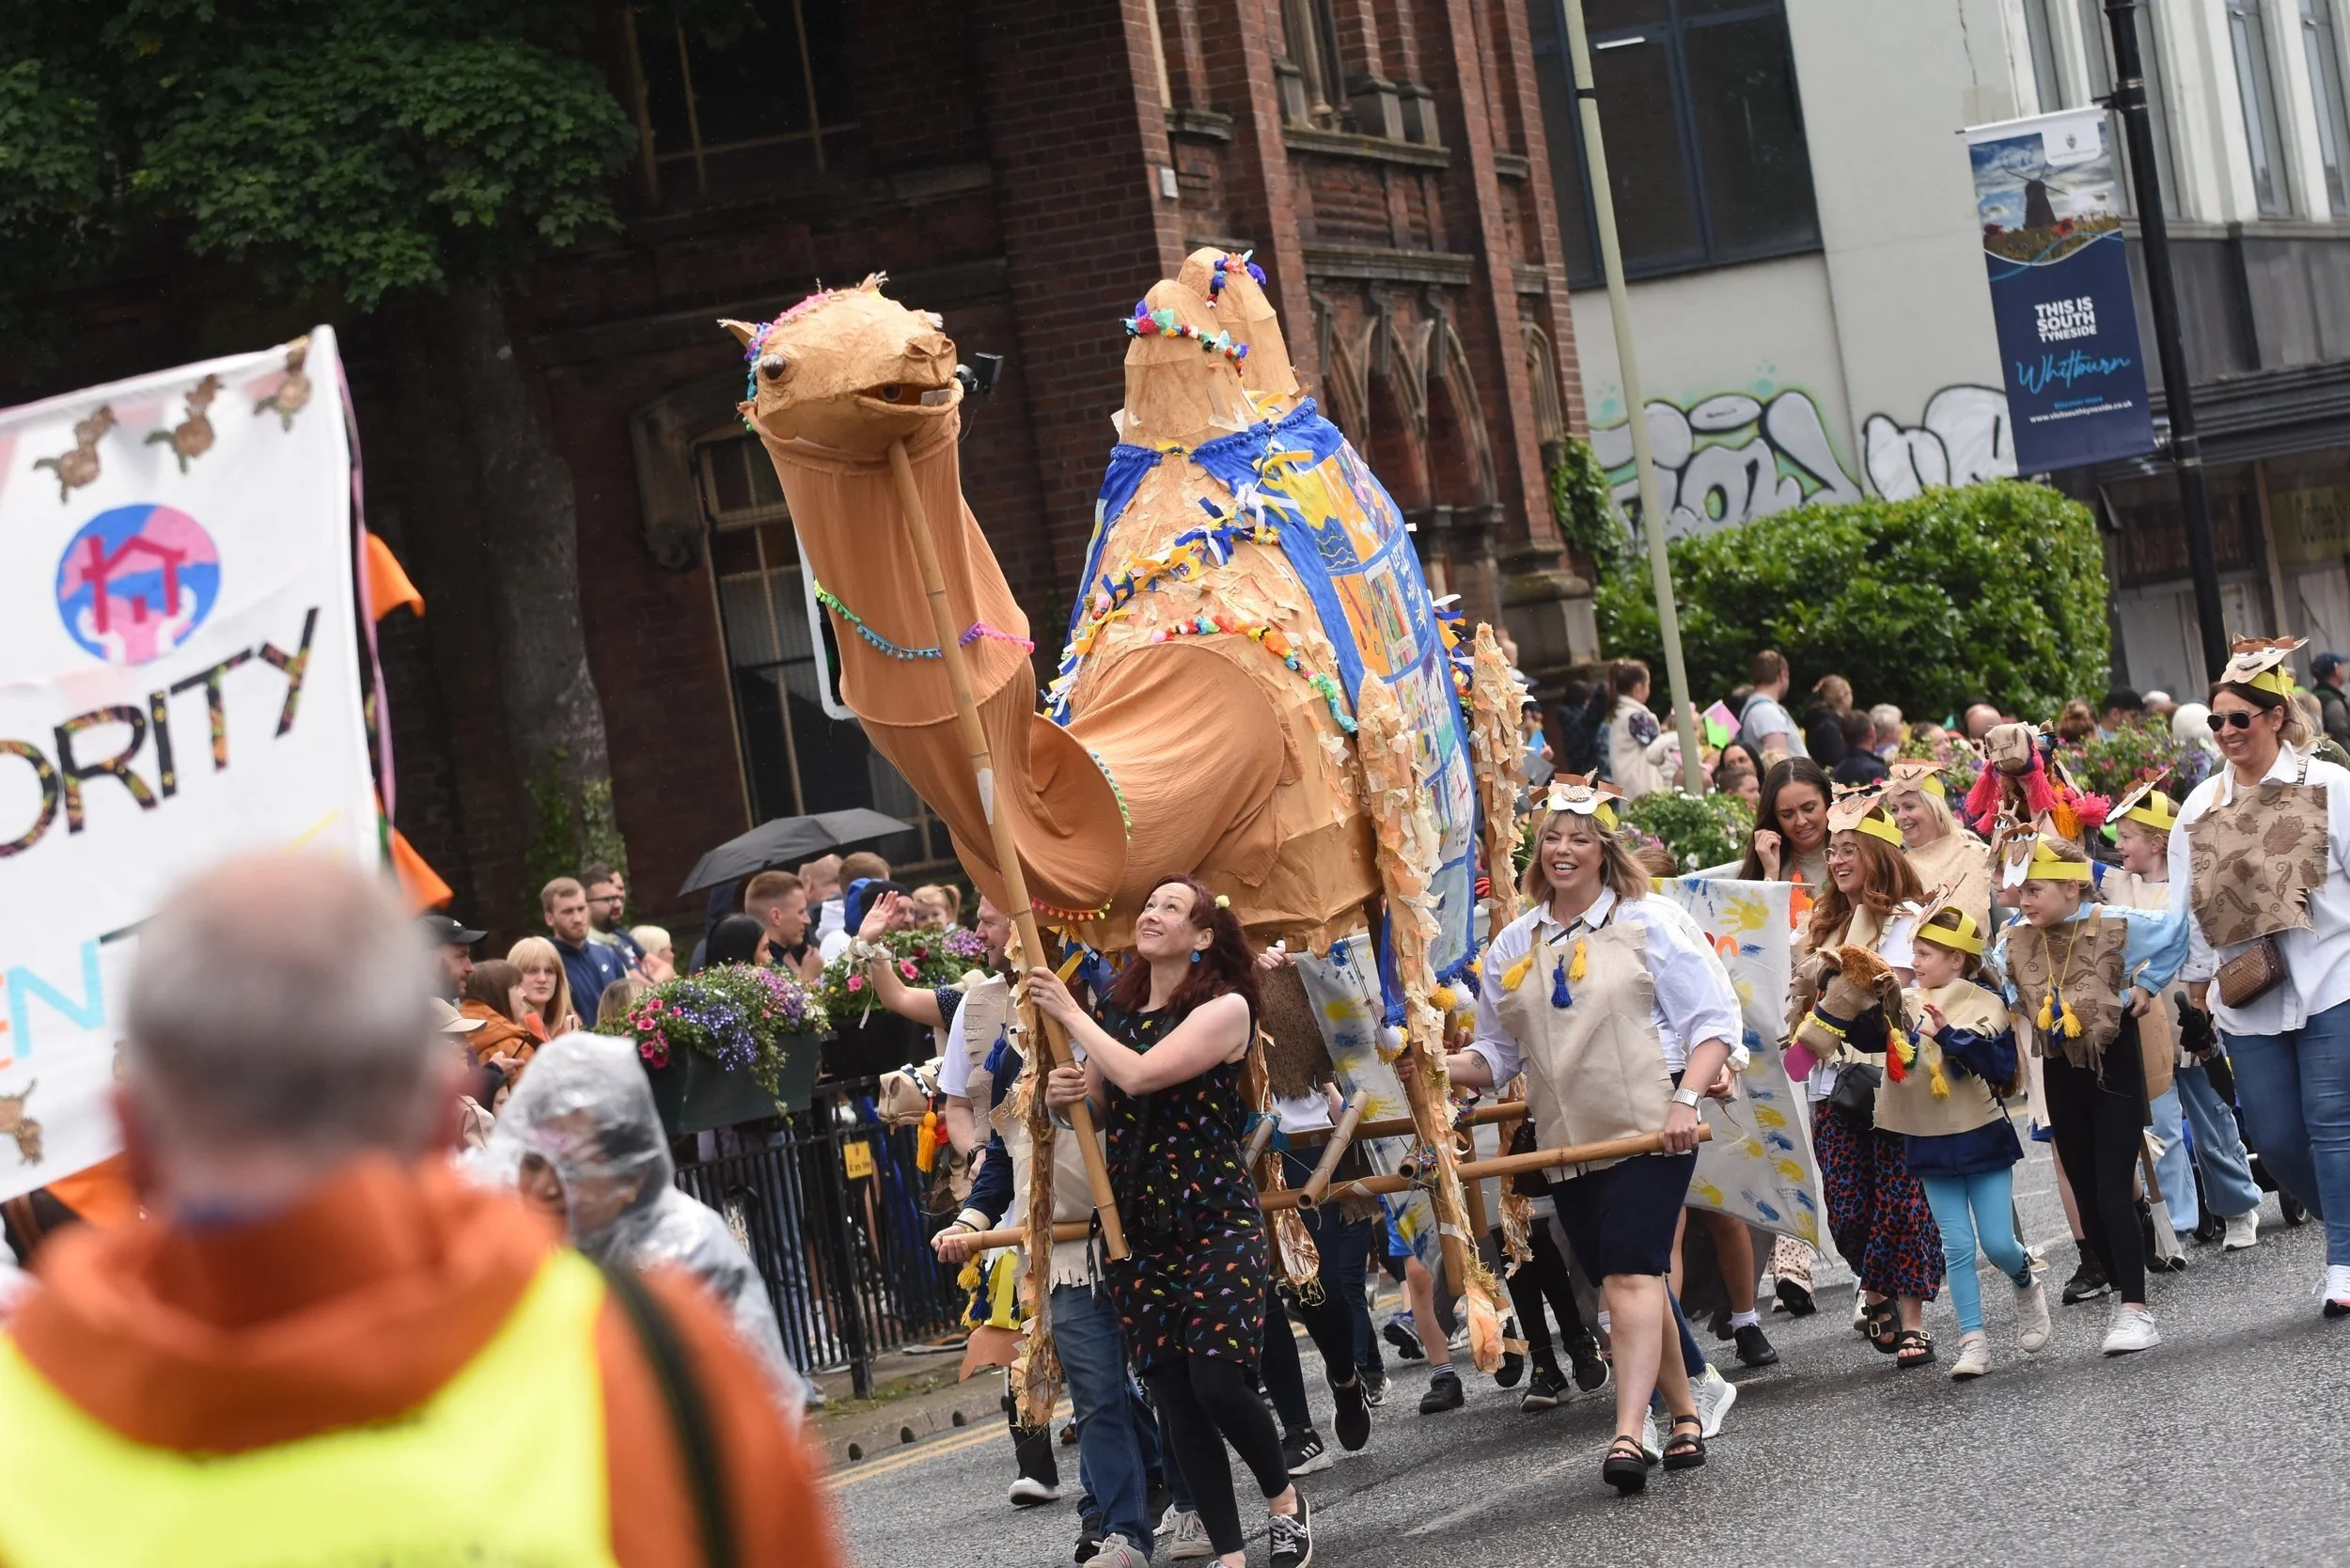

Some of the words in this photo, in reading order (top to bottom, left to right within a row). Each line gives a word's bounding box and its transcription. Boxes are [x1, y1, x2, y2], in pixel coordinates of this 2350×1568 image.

[2034, 299, 2074, 319] THIS
[2076, 296, 2093, 312] IS
[2037, 311, 2096, 333] SOUTH
[2039, 324, 2097, 342] TYNESIDE
[2015, 349, 2131, 394] Whitburn
